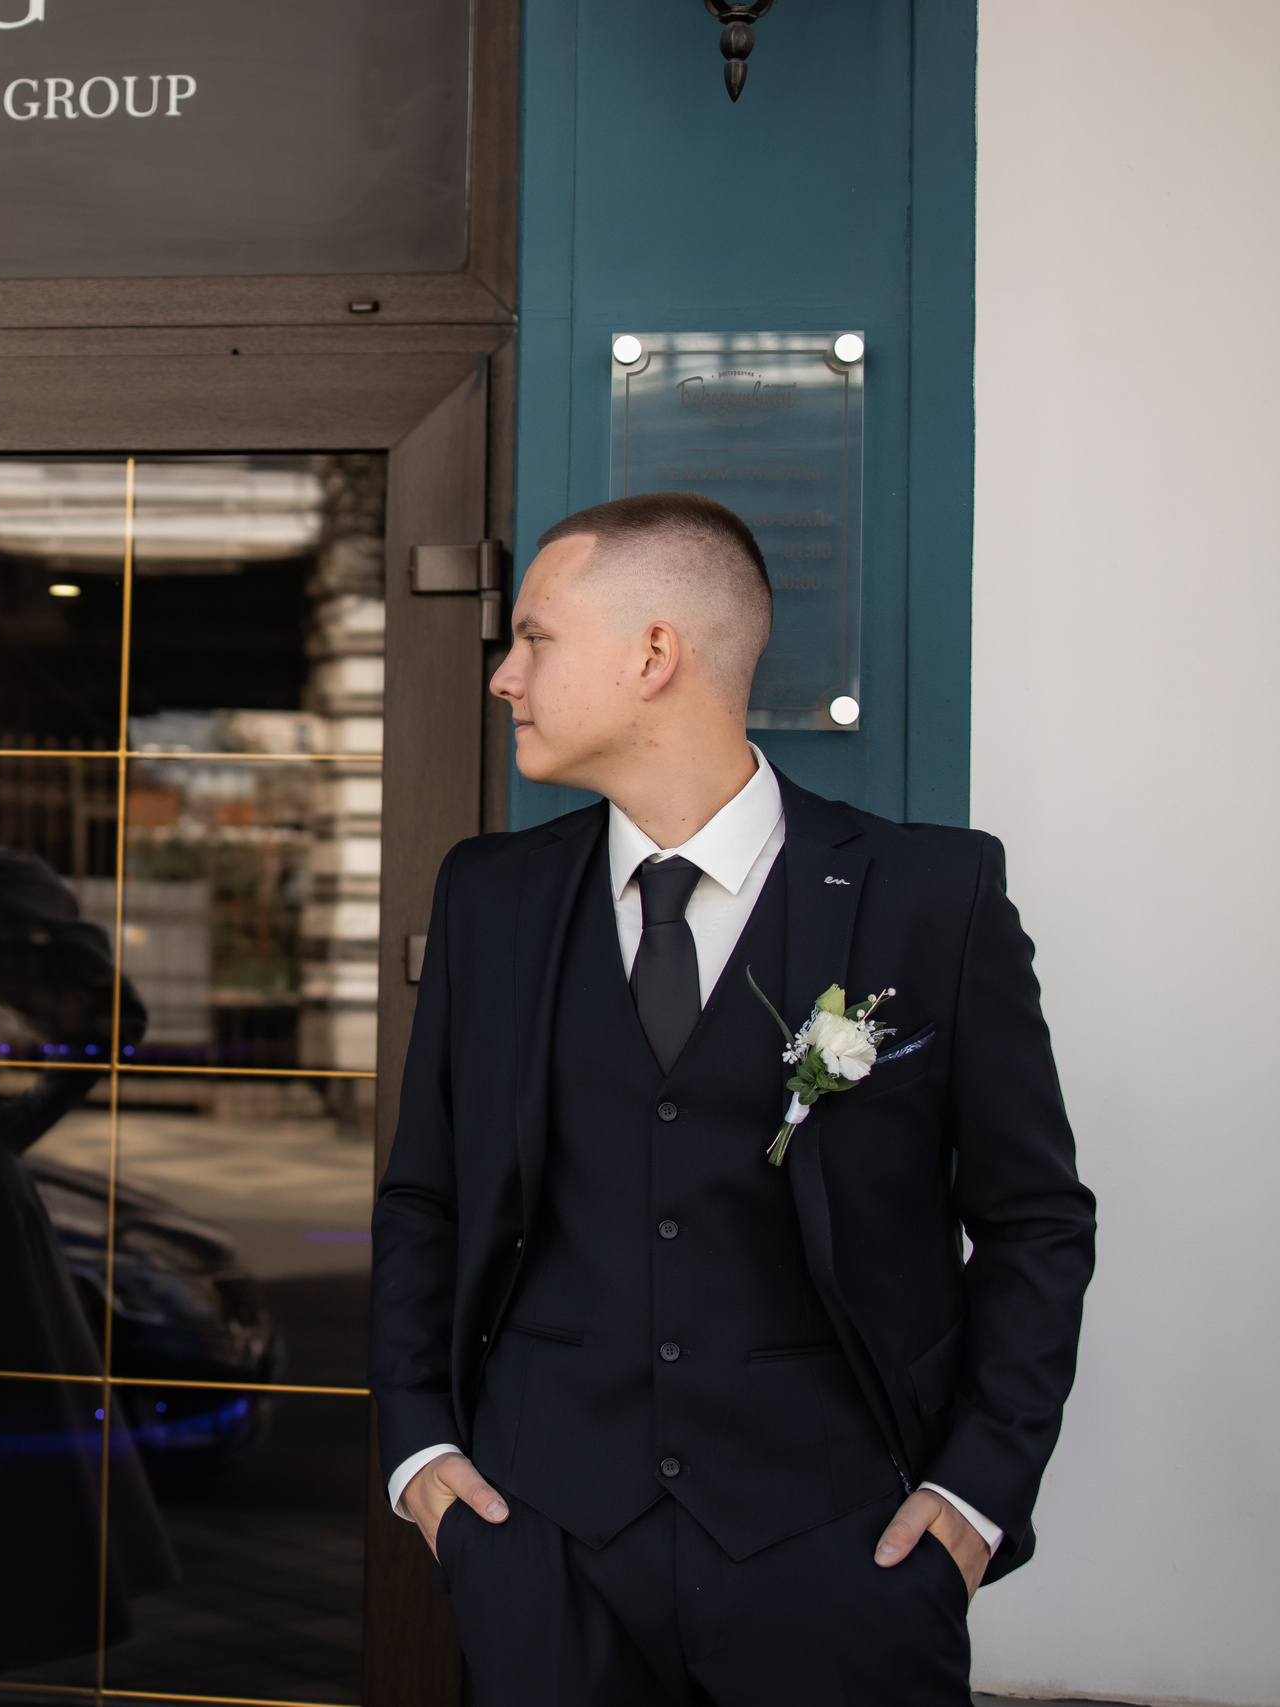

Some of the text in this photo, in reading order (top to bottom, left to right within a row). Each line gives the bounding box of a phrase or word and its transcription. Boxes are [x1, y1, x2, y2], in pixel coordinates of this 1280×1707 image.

[3, 74, 198, 121] GROUP
[657, 466, 821, 481] РЕЖИМ РАБОТЫ
[783, 541, 832, 559] 01:00
